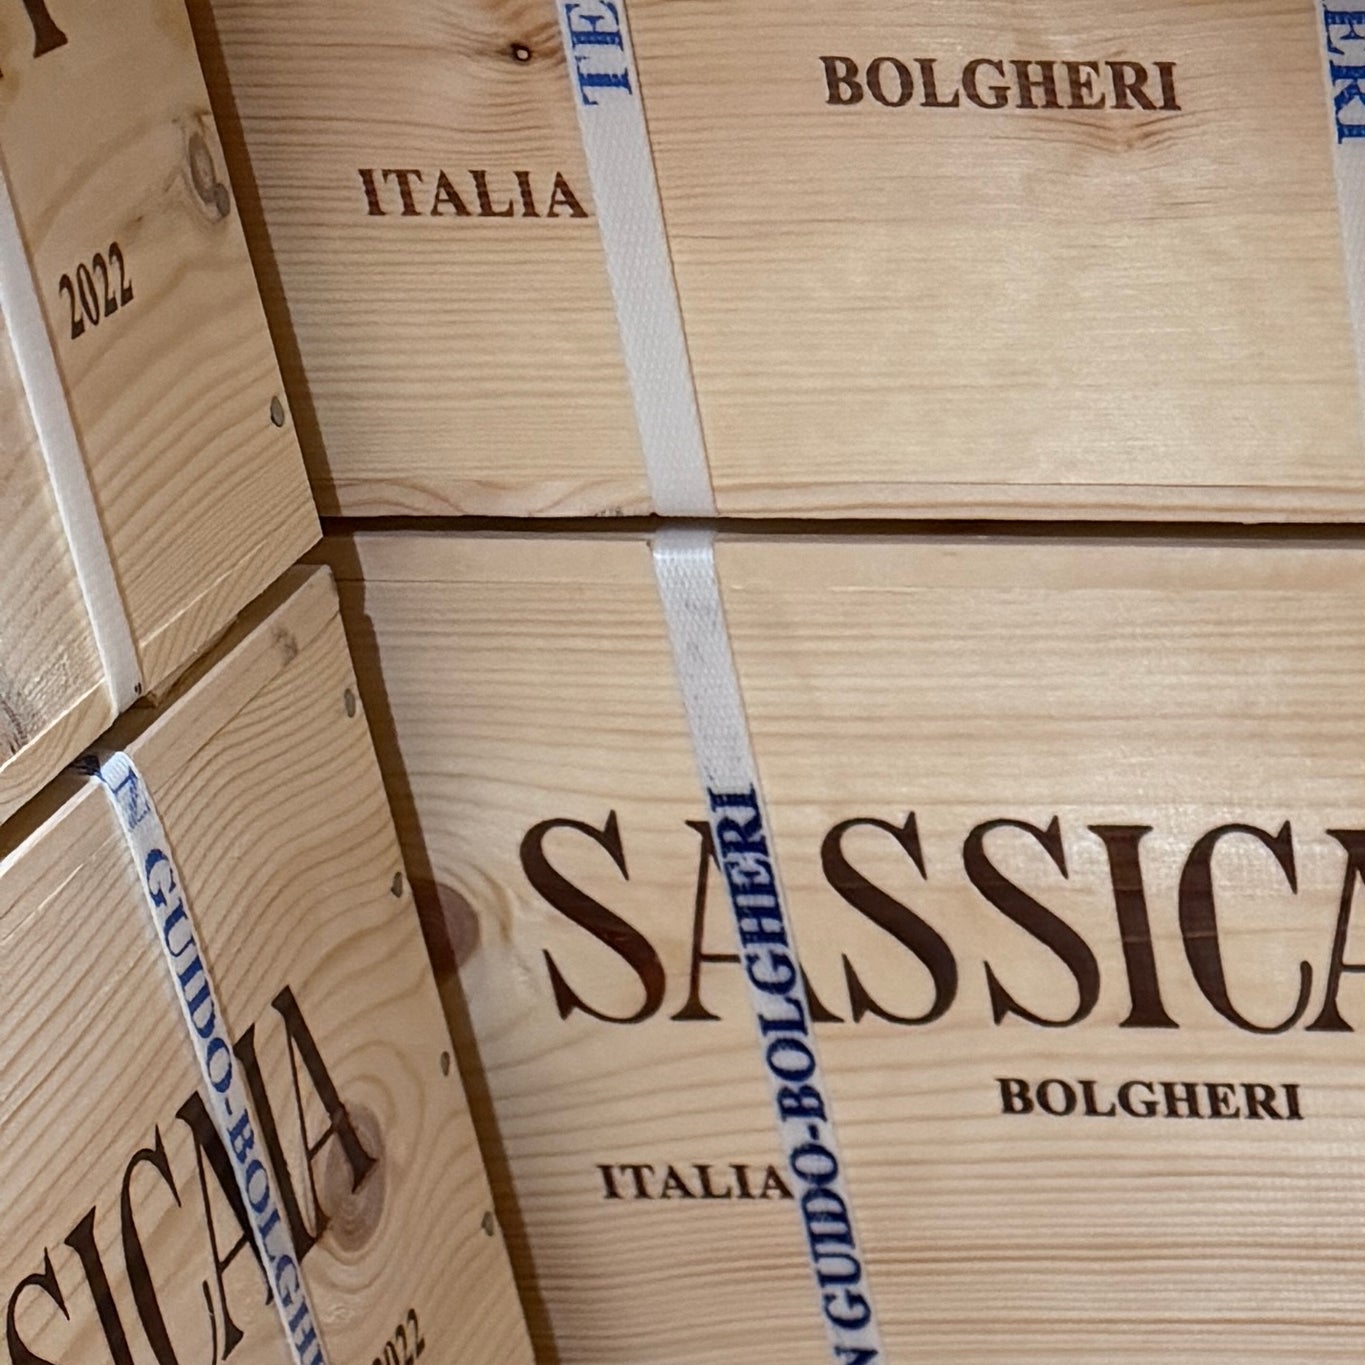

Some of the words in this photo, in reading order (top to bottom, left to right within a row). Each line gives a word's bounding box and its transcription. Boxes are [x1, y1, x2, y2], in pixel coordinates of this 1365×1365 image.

[820, 56, 1182, 112] BOLGHERI
[358, 168, 592, 219] ITALIA
[58, 242, 135, 340] 2022
[708, 785, 873, 1331] GUIDO-BOLGHERI
[995, 1077, 1305, 1121] BOLGHERI
[597, 1163, 794, 1200] ITALIA
